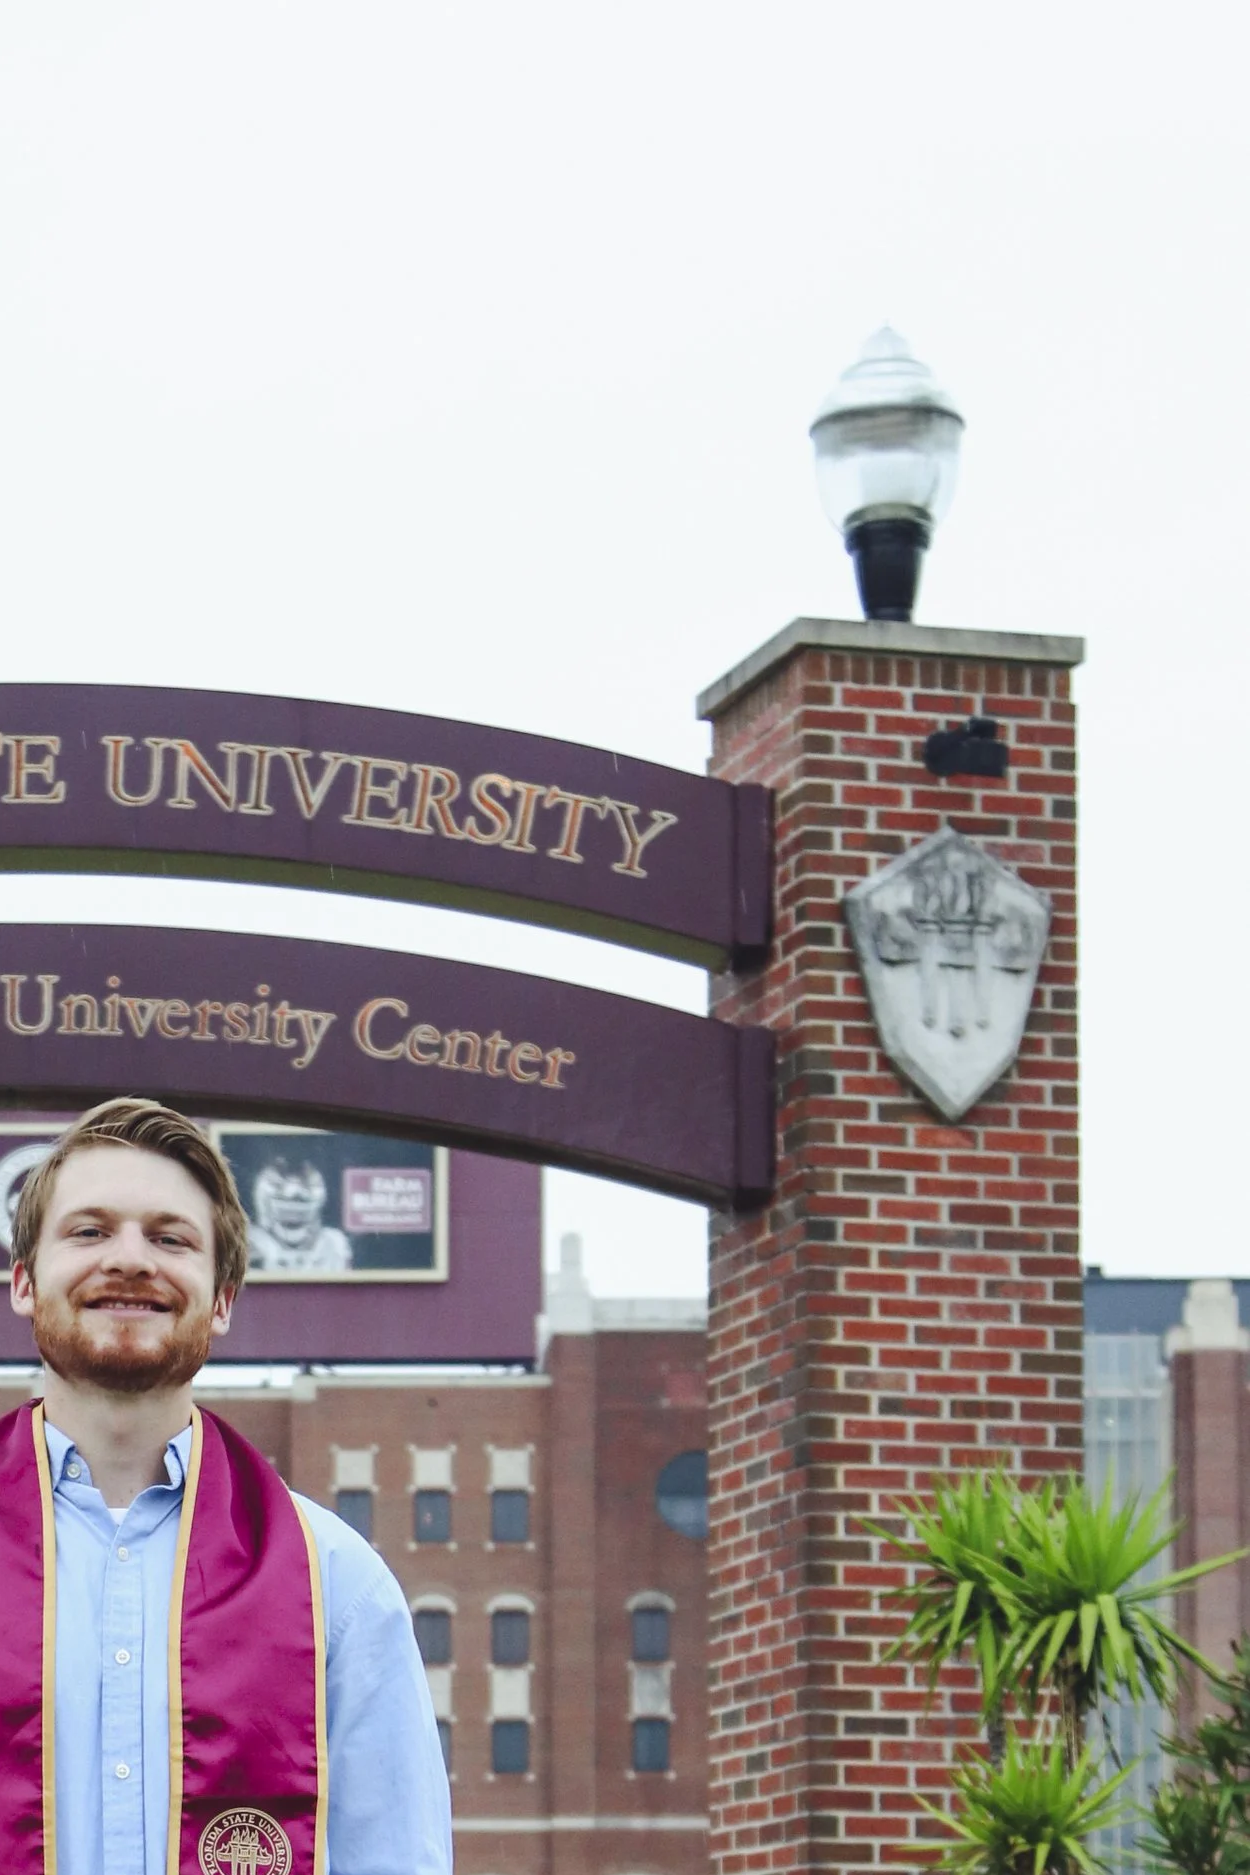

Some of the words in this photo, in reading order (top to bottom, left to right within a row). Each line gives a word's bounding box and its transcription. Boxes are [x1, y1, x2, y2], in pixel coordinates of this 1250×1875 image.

[101, 735, 678, 878] UNIVERSITY
[0, 974, 335, 1070] University
[353, 998, 575, 1089] Center
[204, 1826, 223, 1875] FLORIDA
[222, 1813, 255, 1828] STATE
